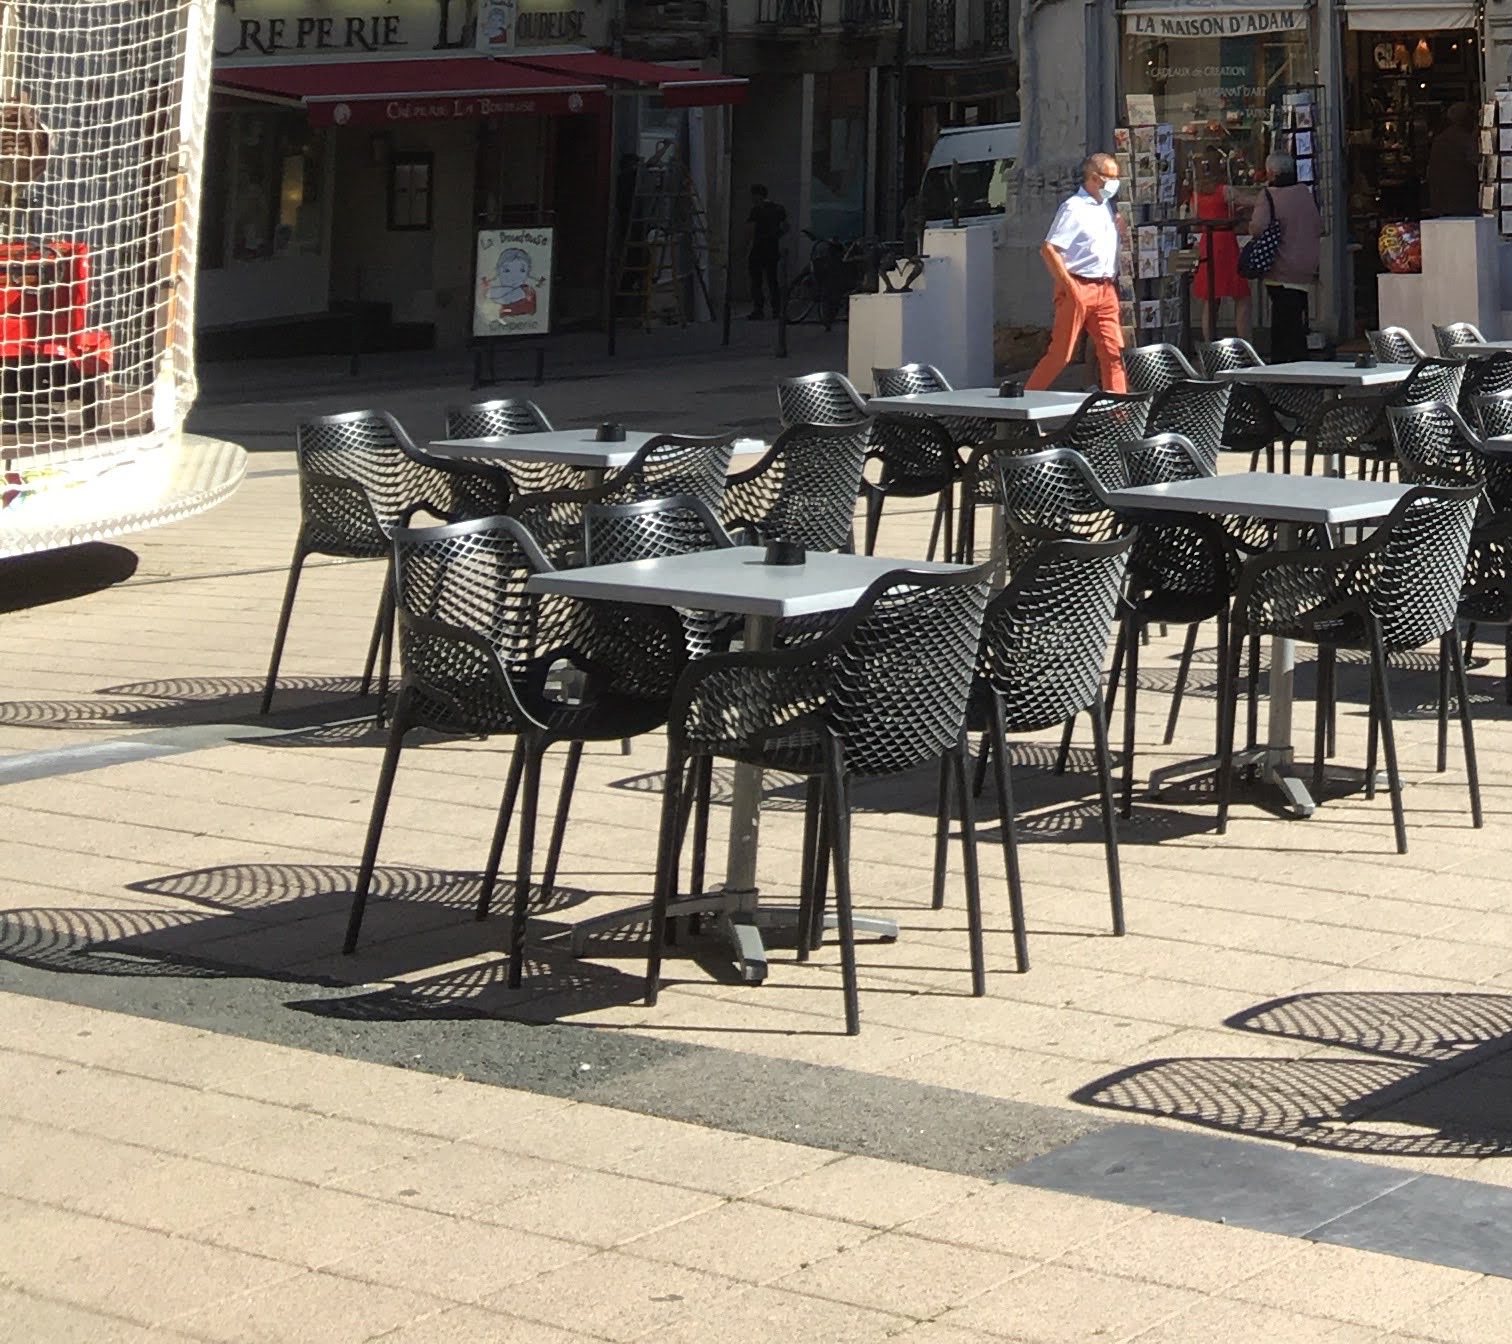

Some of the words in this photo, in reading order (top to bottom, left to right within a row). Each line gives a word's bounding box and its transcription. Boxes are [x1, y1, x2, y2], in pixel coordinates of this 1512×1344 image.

[517, 12, 588, 43] OUDEUSE
[1136, 16, 1155, 32] LA
[1160, 16, 1224, 35] MAISON
[1229, 12, 1295, 33] D'ADAM
